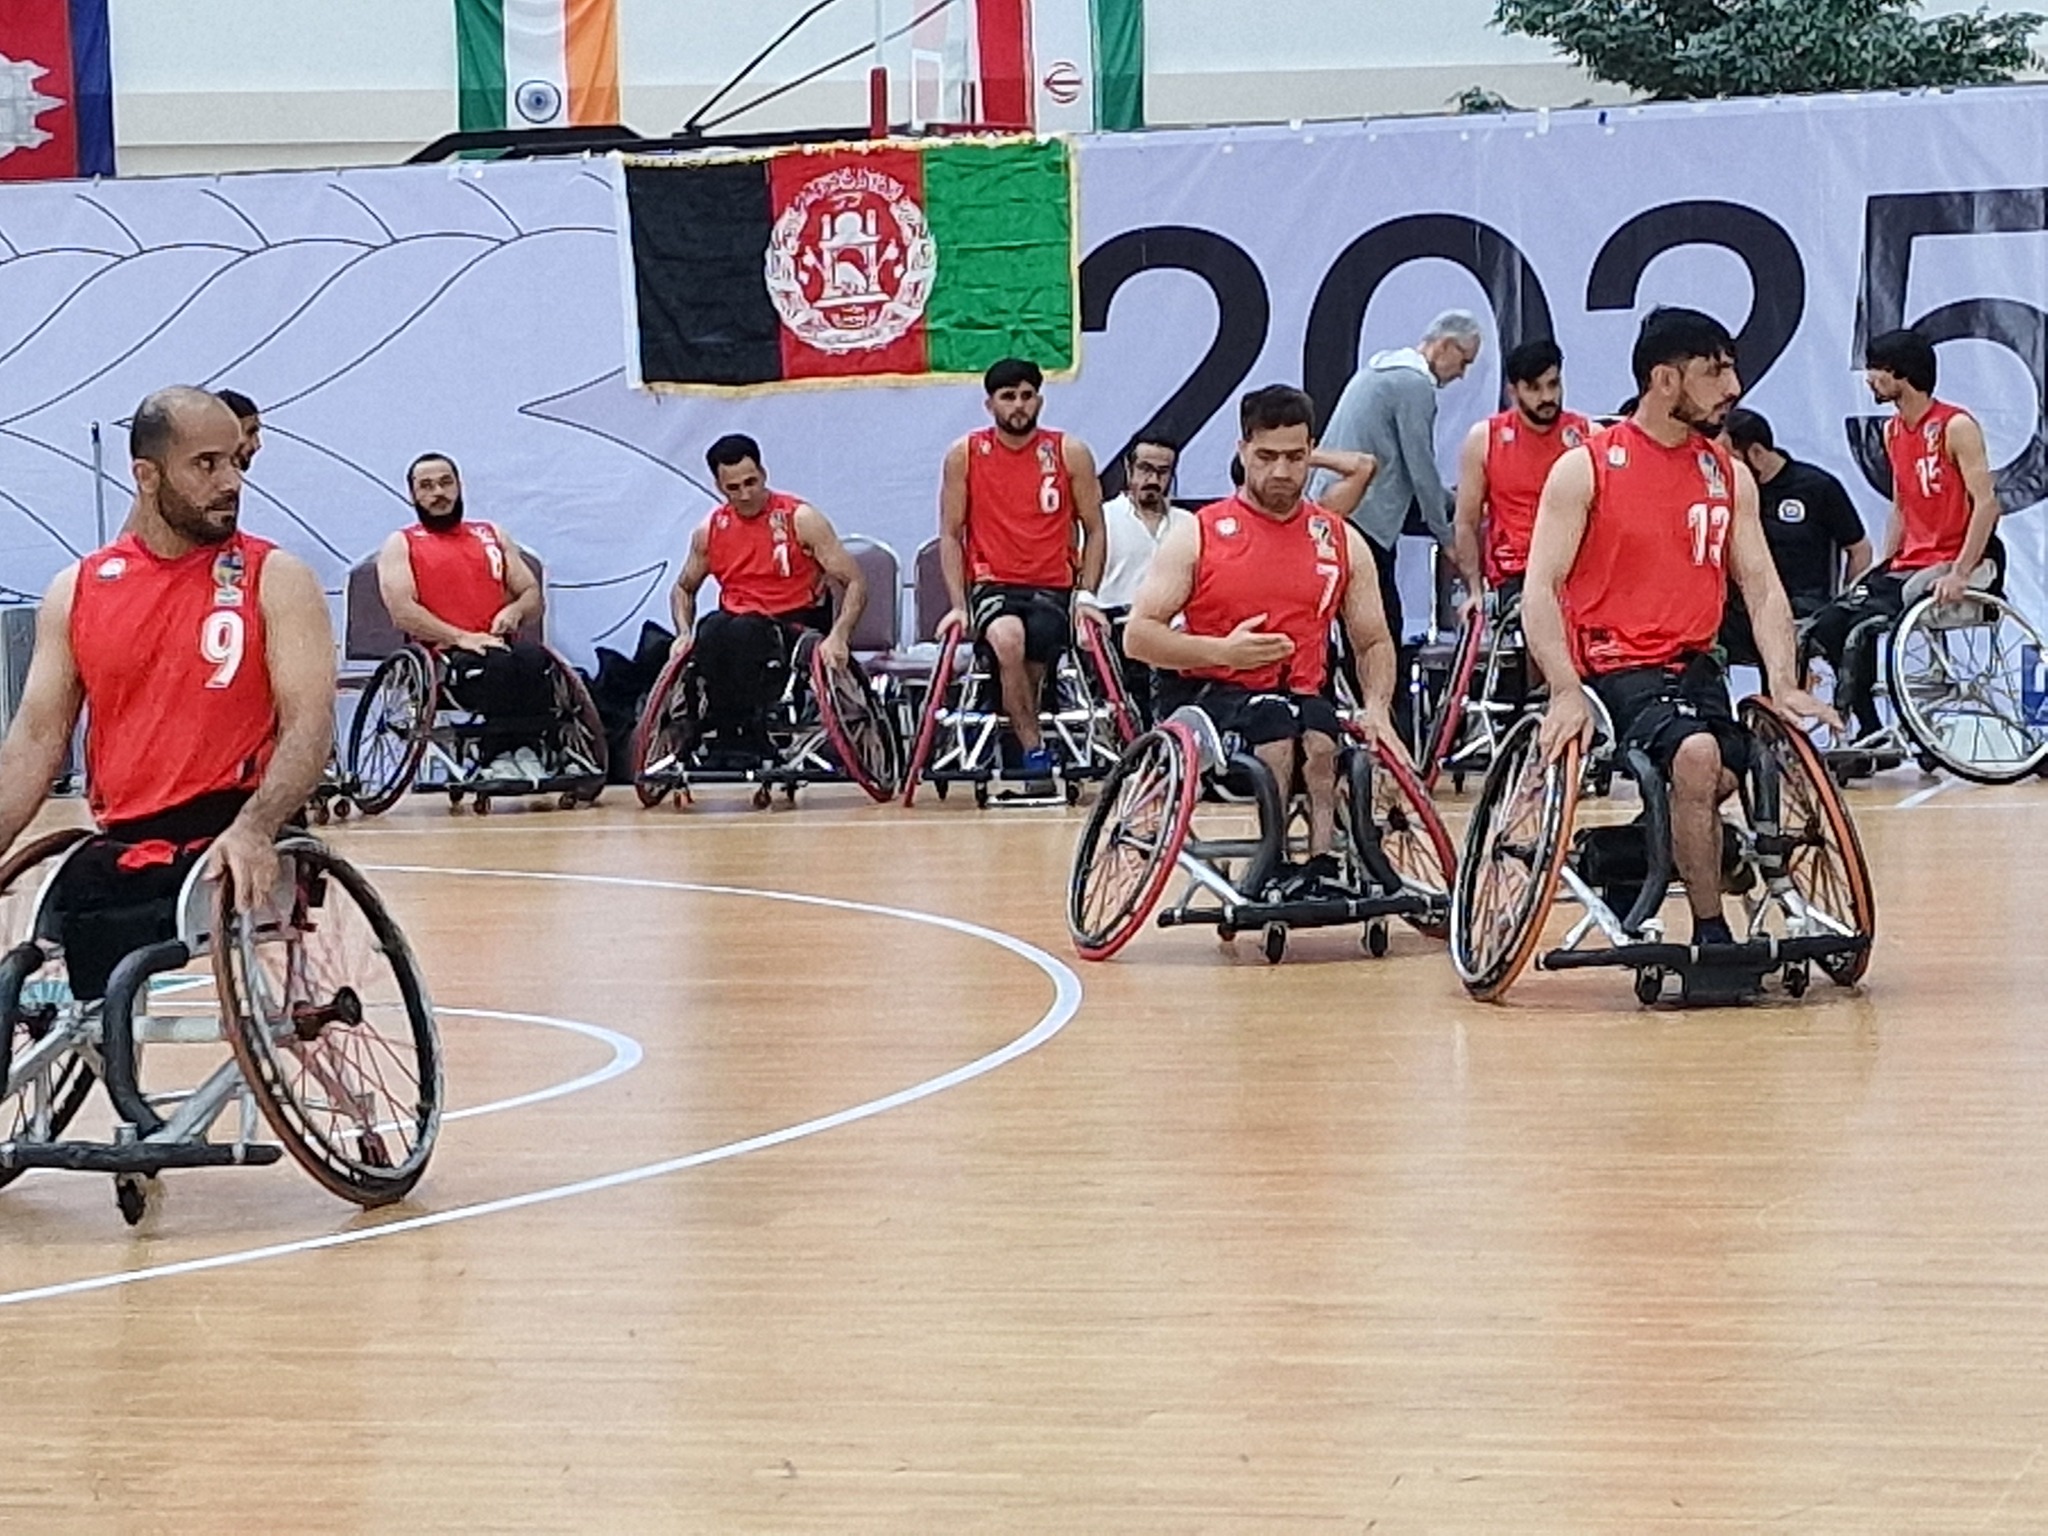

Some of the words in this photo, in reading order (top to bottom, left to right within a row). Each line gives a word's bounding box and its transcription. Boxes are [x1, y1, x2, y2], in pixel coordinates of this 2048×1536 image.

[1079, 189, 2048, 536] 2025
[1040, 475, 1060, 514] 6
[1915, 452, 1943, 499] 15
[1687, 502, 1730, 568] 13
[1314, 562, 1340, 619] 7
[201, 609, 245, 689] 9
